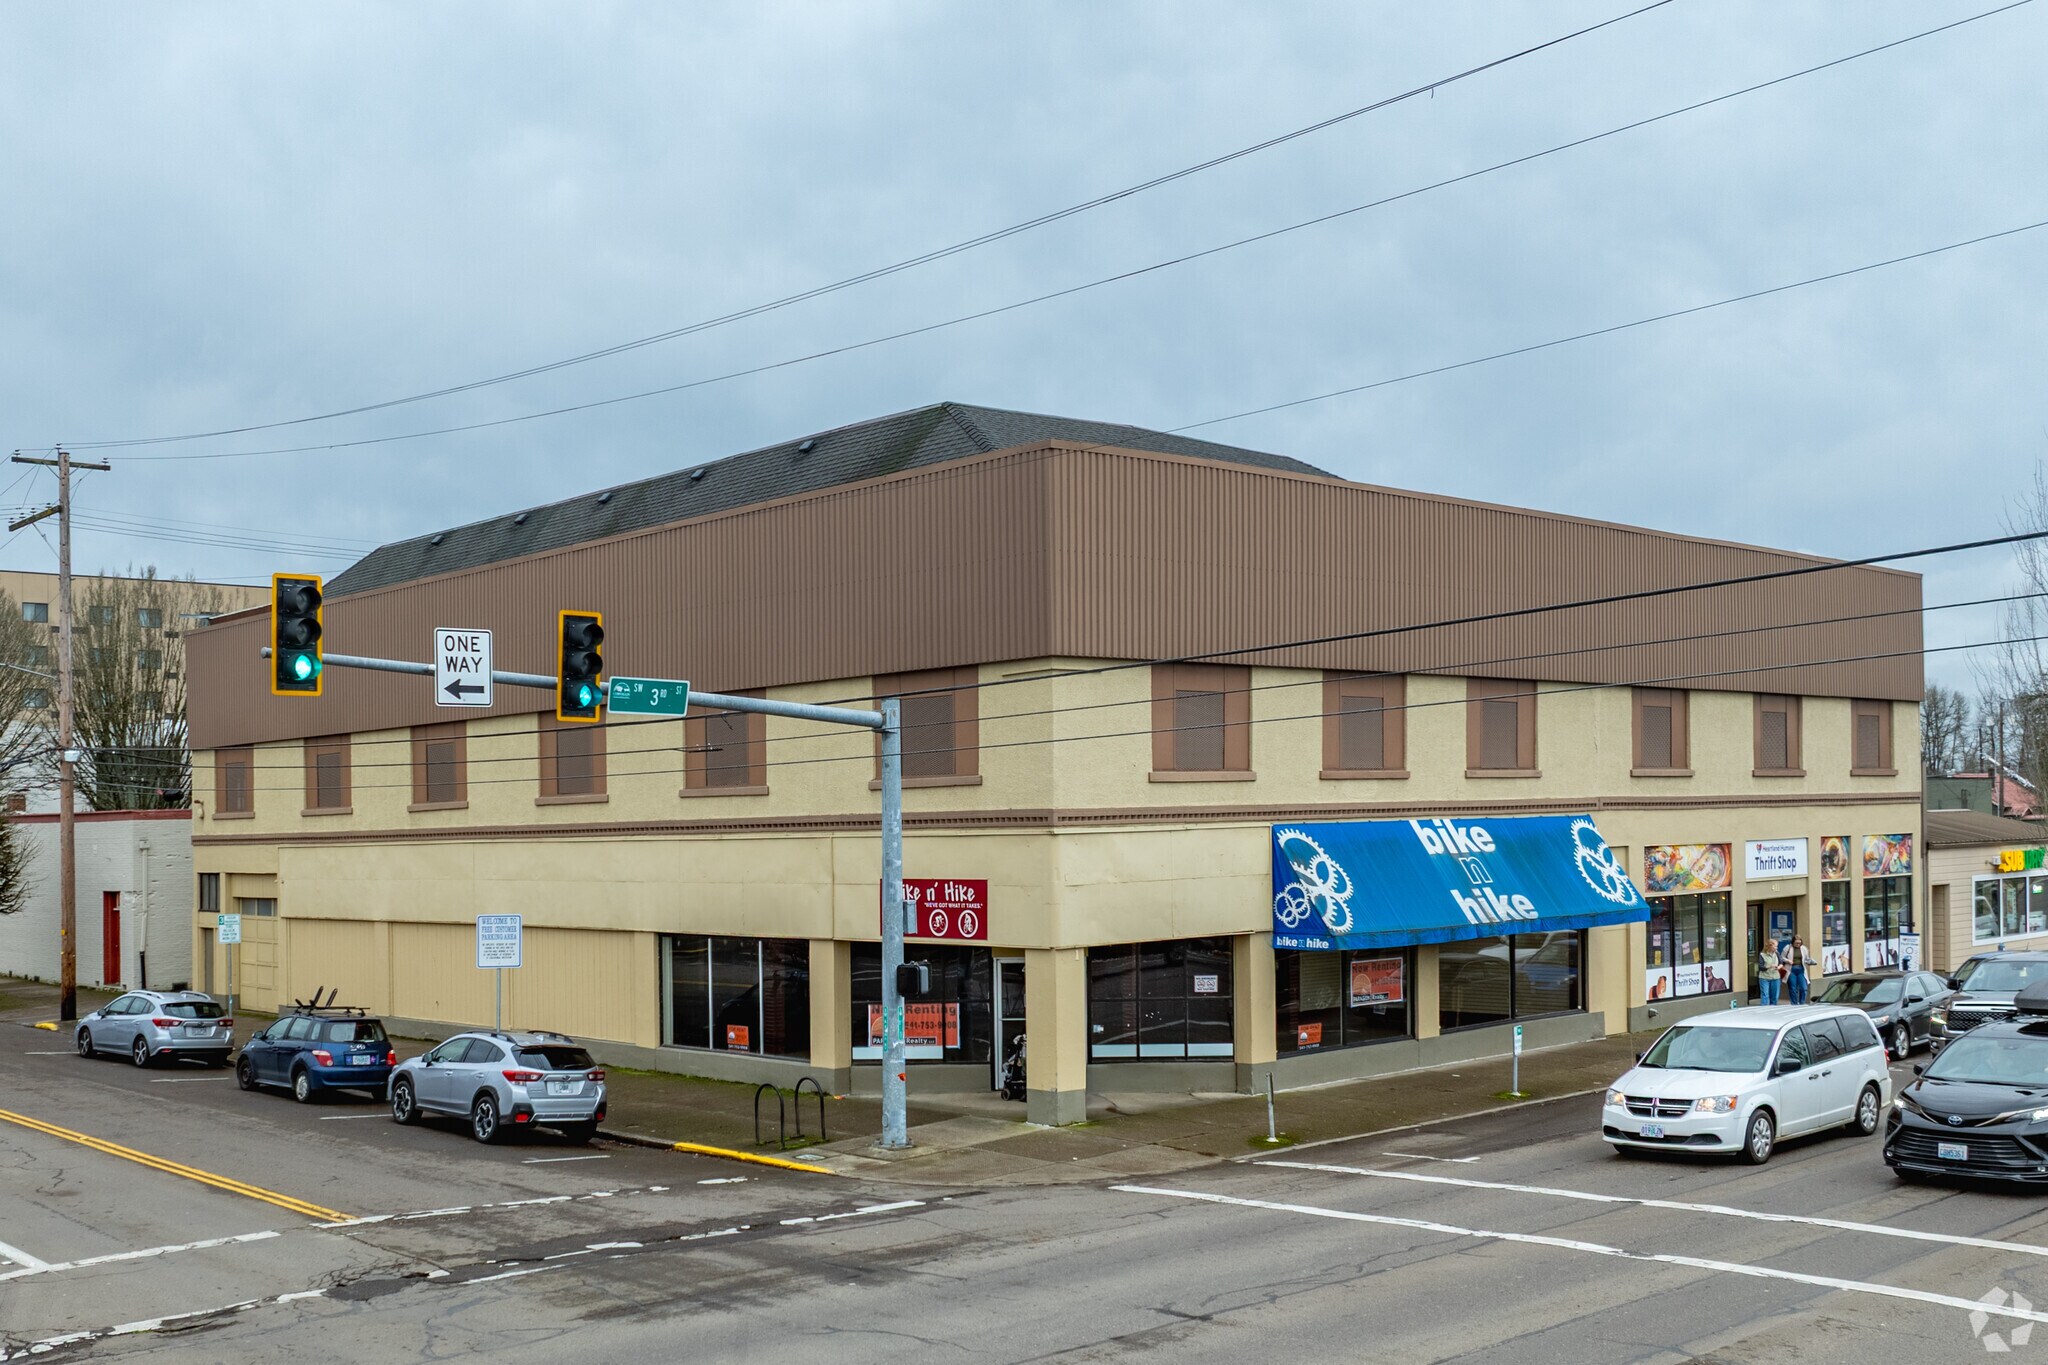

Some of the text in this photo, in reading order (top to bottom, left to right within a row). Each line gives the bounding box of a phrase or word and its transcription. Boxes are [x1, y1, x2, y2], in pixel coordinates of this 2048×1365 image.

[445, 635, 480, 652] ONE
[445, 656, 483, 673] WAY
[633, 683, 643, 692] SW
[675, 685, 683, 695] ST
[1409, 819, 1496, 854] bike
[1458, 857, 1493, 884] n
[1755, 855, 1797, 872] Thrift Shop
[902, 884, 921, 901] ike
[944, 881, 975, 902] Hike
[1450, 887, 1539, 924] hike
[219, 916, 224, 924] 3
[1276, 936, 1298, 947] bike
[1306, 937, 1330, 949] hike
[906, 1005, 957, 1016] Rentig
